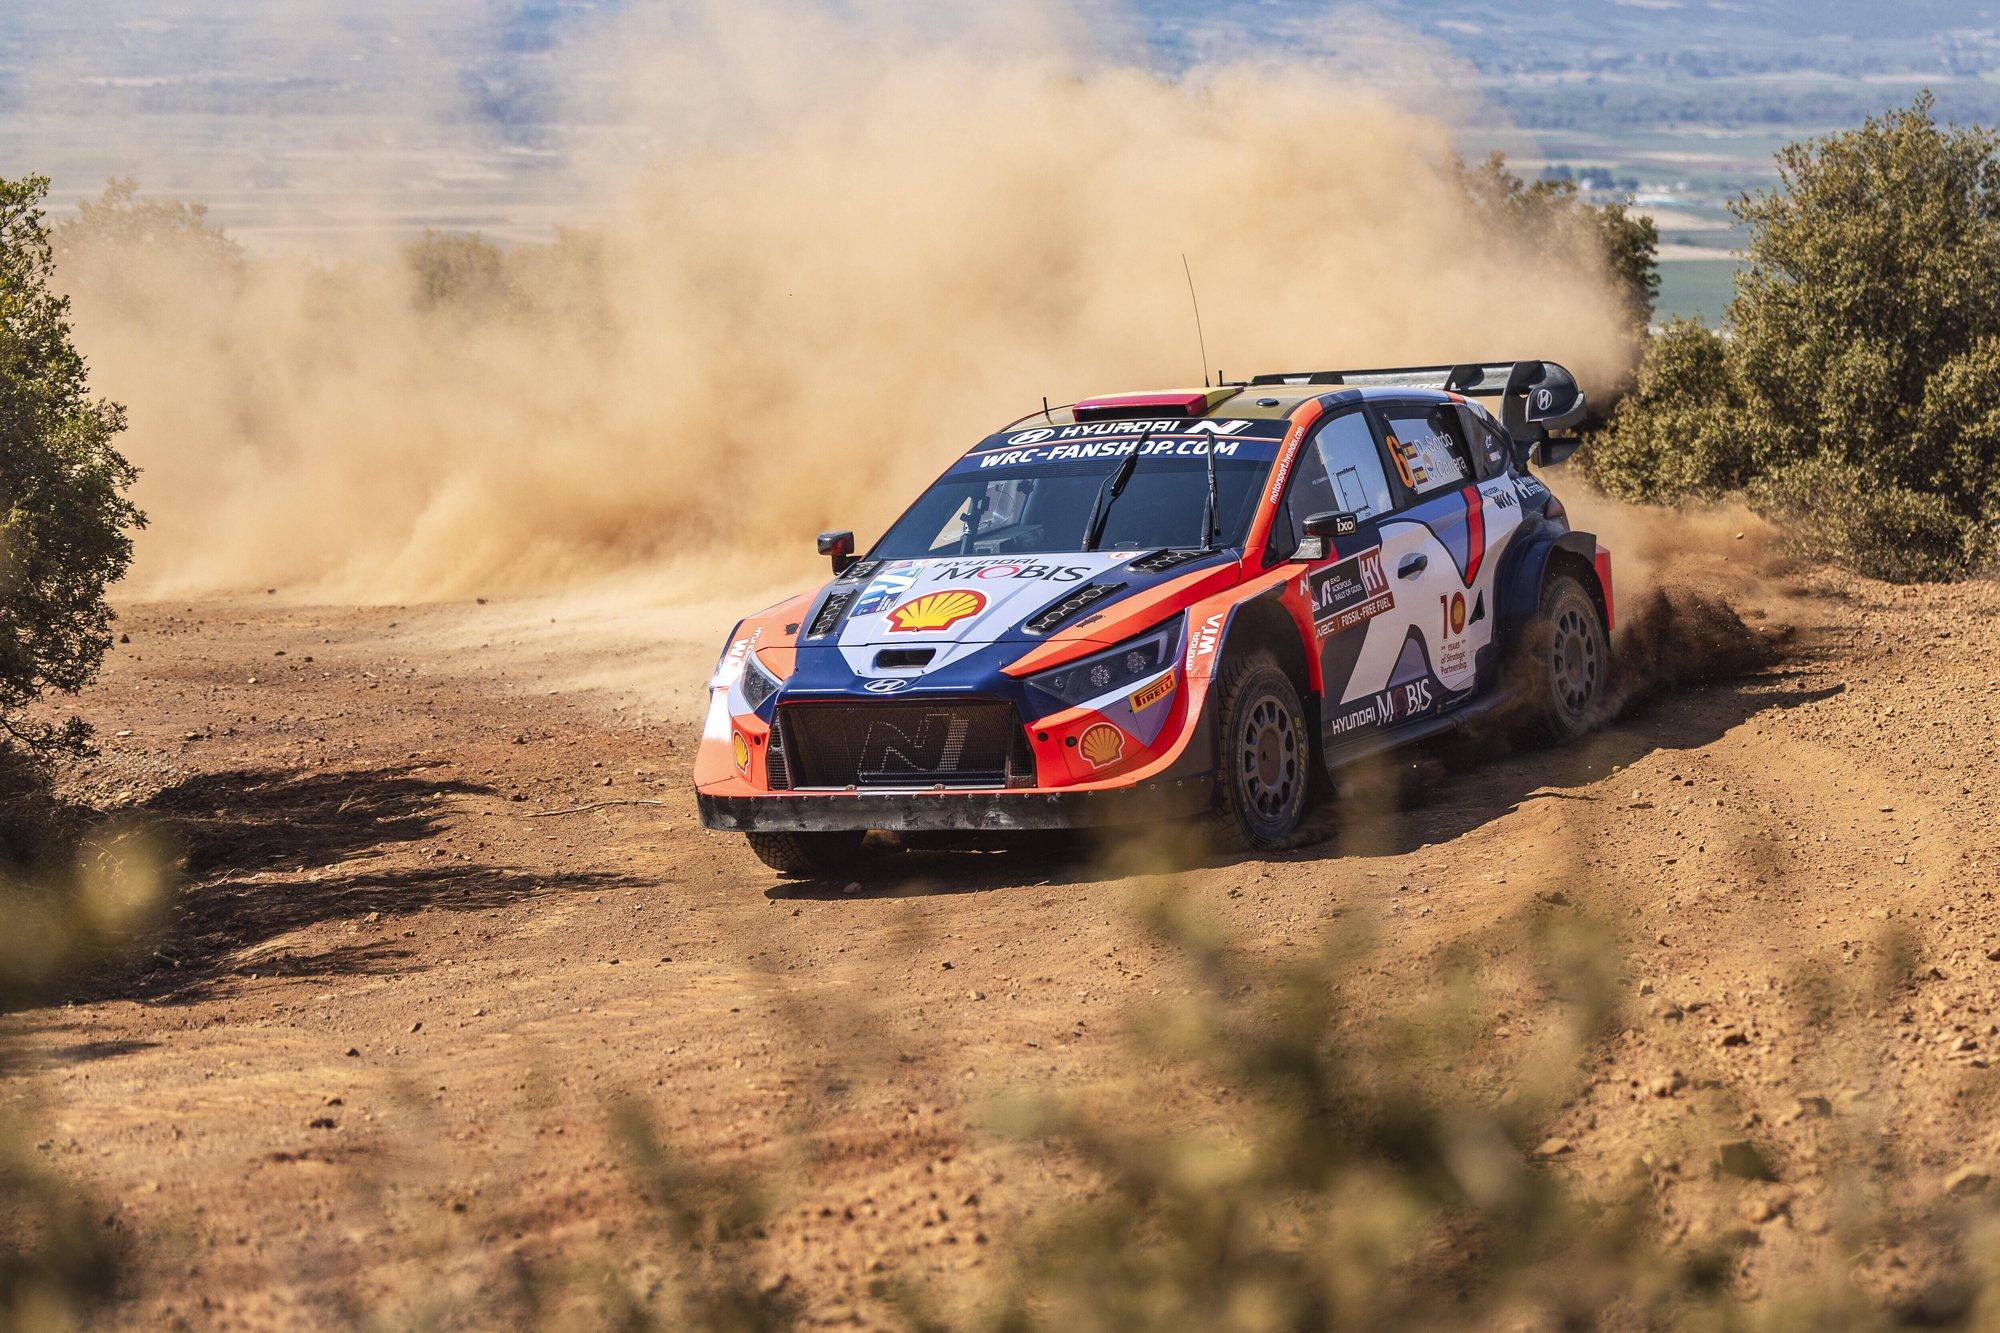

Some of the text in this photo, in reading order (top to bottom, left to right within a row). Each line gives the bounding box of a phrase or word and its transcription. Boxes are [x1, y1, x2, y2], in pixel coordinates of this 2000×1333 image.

[1059, 420, 1180, 438] HYUNDAI
[979, 440, 1239, 468] WRC-FANSHOP.COM
[1269, 426, 1305, 504] motorsport.hyundai.com
[1386, 435, 1414, 488] 6
[1336, 518, 1354, 532] ixo
[931, 565, 1091, 581] MOBIS
[934, 558, 1038, 568] HYUNDAI
[1361, 555, 1384, 591] HY
[1341, 604, 1377, 627] FOSSIL-FREE
[1376, 596, 1391, 612] FUEL
[1134, 674, 1174, 707] PIRELLI
[1332, 678, 1433, 735] HYUNDAI MOBIS
